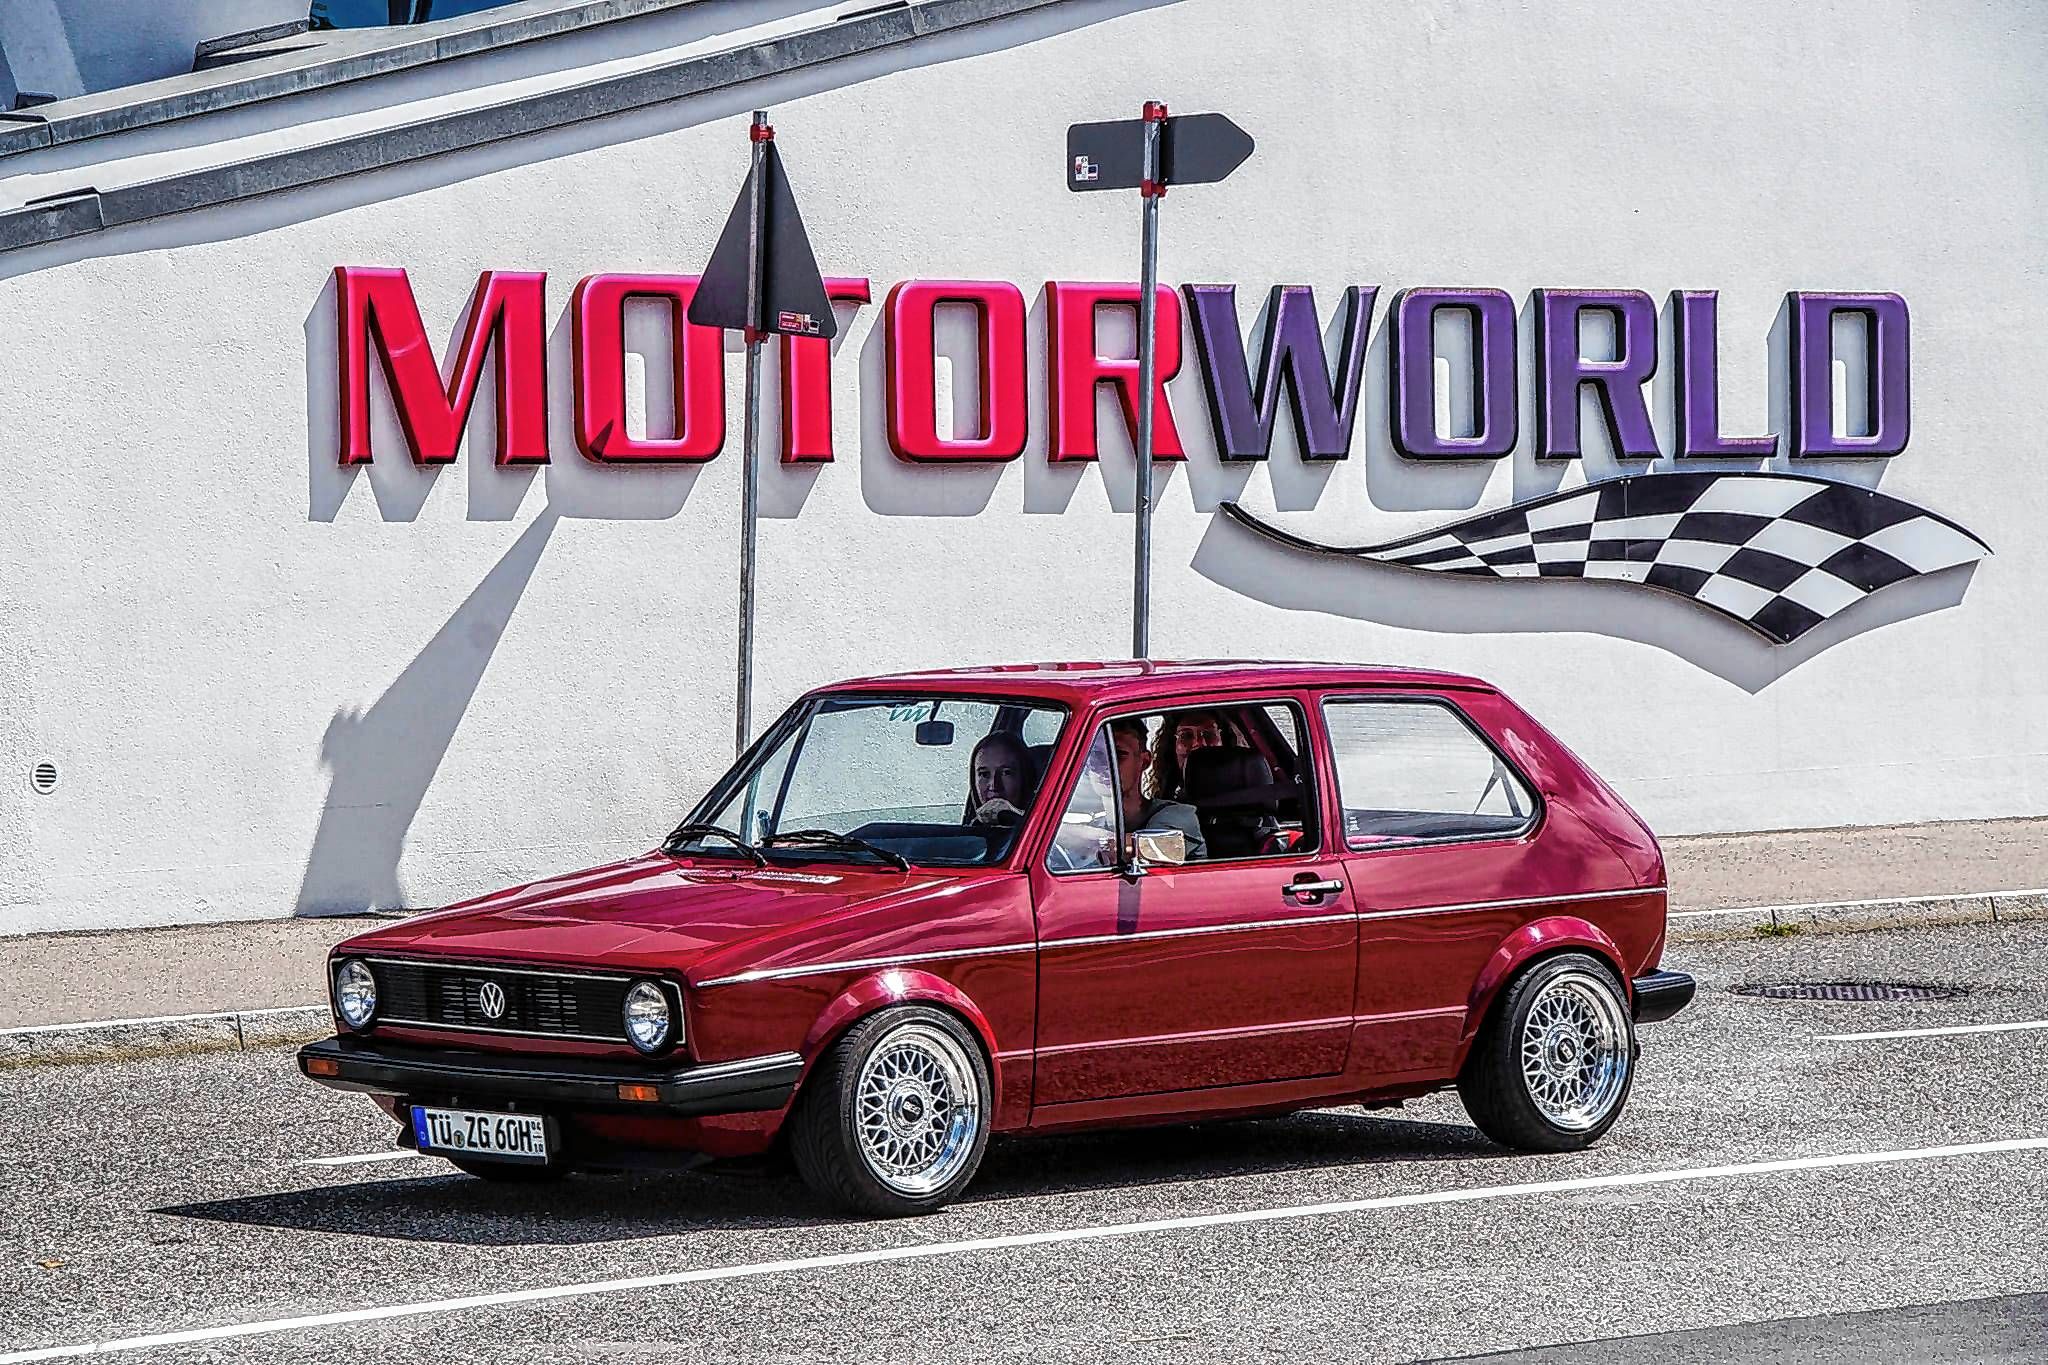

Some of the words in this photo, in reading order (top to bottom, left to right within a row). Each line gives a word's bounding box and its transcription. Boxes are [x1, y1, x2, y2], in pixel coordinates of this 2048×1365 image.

[427, 1113, 453, 1147] TÜ
[465, 1116, 491, 1148] ZG
[495, 1118, 532, 1152] 60H
